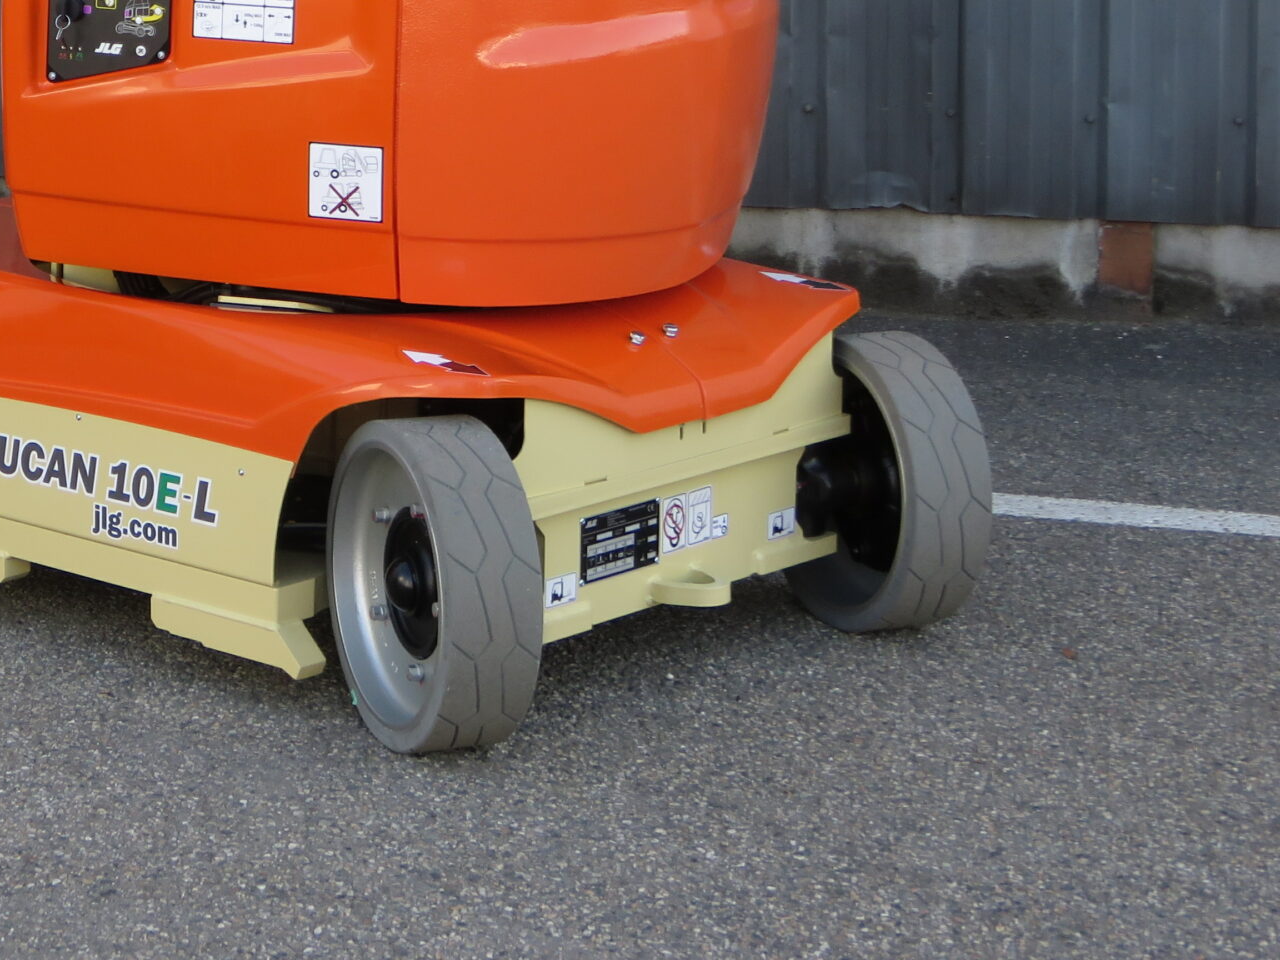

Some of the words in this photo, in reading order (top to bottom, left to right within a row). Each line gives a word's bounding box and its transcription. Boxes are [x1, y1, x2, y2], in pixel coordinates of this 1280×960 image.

[94, 42, 124, 55] JLG
[106, 461, 218, 525] 10E-L
[91, 503, 178, 548] jlg.com
